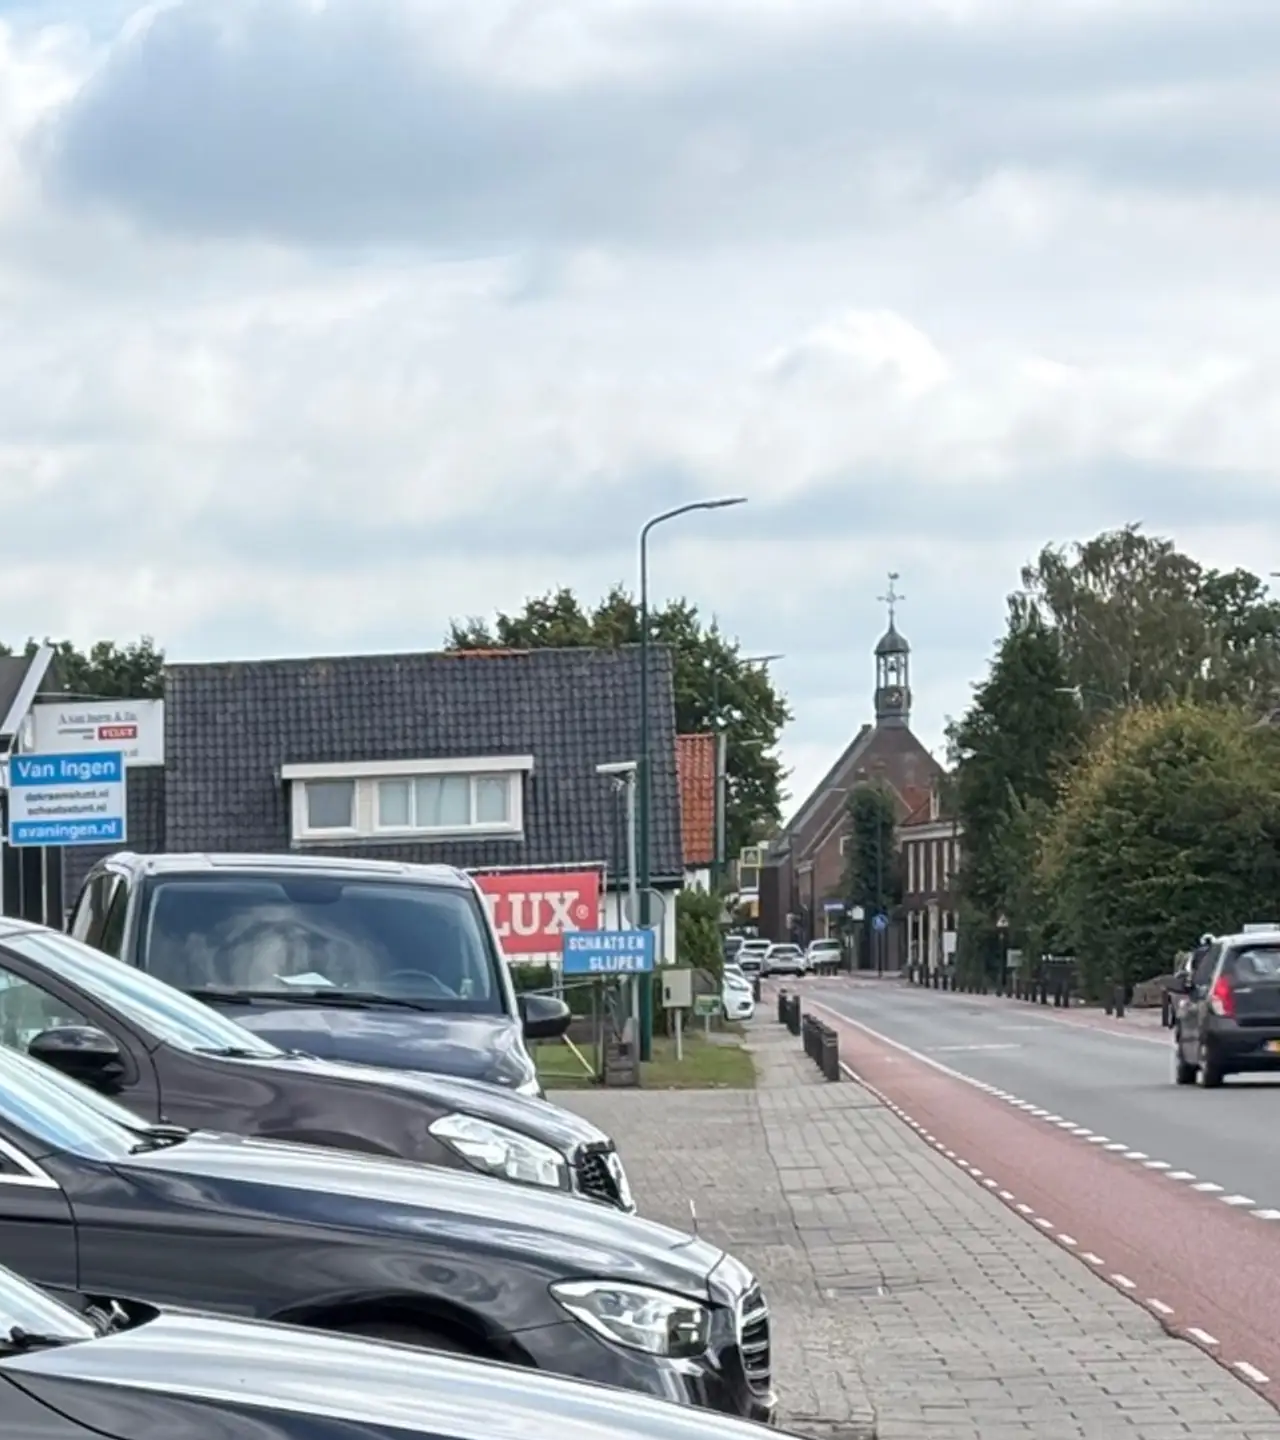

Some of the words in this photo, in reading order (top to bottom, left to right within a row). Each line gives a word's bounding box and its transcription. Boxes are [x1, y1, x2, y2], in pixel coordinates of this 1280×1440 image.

[18, 761, 55, 778] Van
[60, 760, 116, 780] Ingen
[18, 820, 116, 839] avaningen.nl
[589, 955, 645, 971] SLIJPEN
